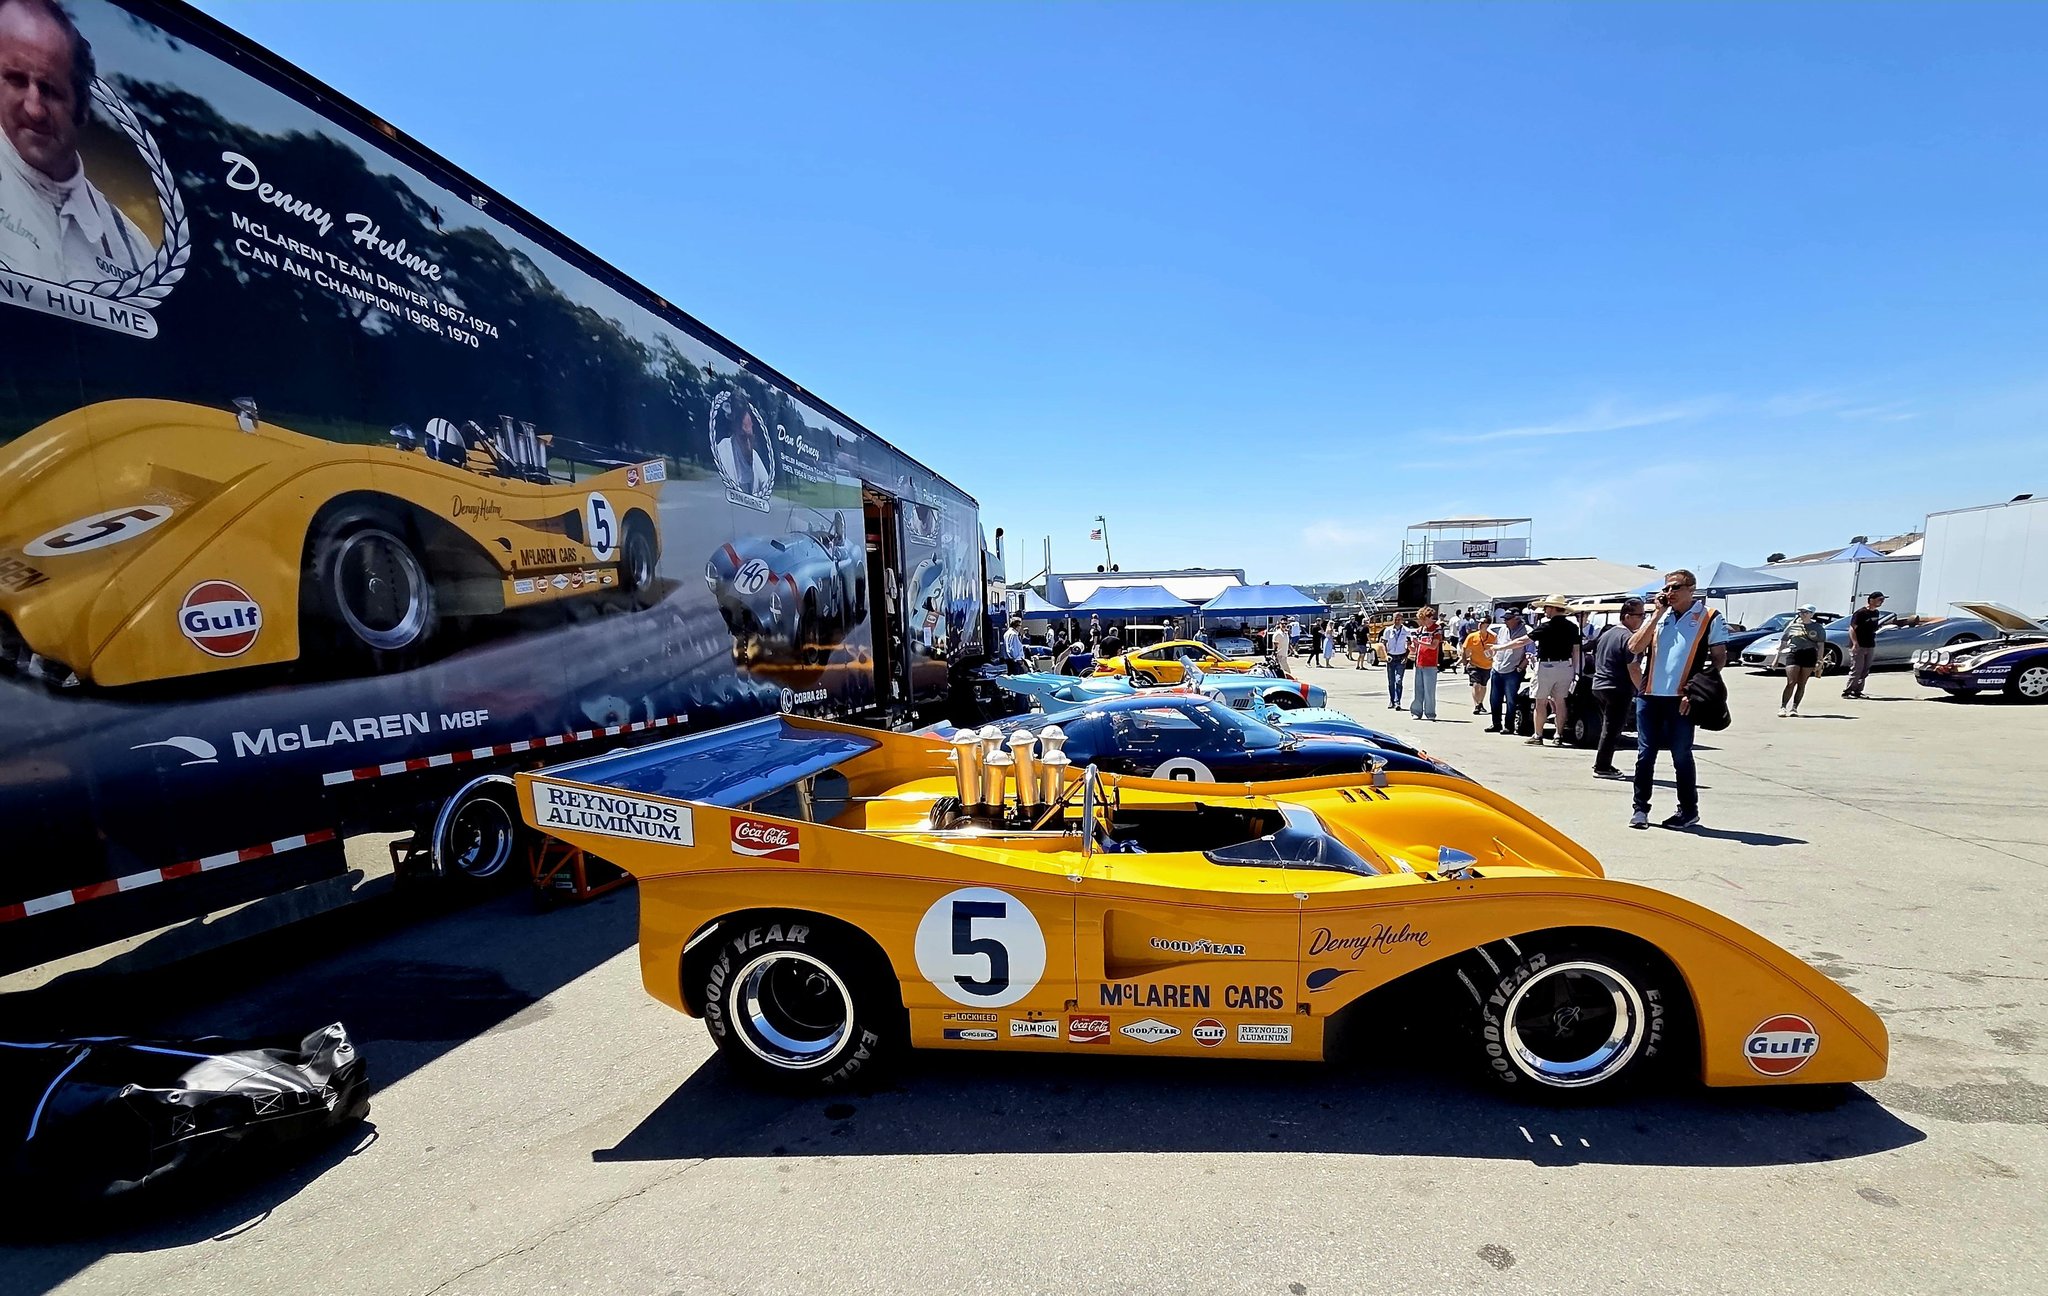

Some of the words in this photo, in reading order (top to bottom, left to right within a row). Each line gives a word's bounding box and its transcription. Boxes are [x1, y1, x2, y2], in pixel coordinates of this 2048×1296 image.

[222, 151, 334, 237] Denny
[345, 213, 442, 281] Hulme
[235, 238, 279, 269] CAN
[282, 257, 311, 281] AM
[314, 270, 400, 317] CHAMPION
[405, 307, 444, 336] 1968,
[447, 325, 480, 349] 1970
[325, 252, 374, 285] TEAM
[376, 273, 429, 309] DRIVER
[433, 300, 499, 339] 1967-1974
[47, 290, 148, 333] HULME
[777, 424, 794, 447] Dan
[796, 435, 820, 461] Gurney
[453, 495, 479, 522] Denny
[44, 509, 160, 549] 5
[592, 499, 610, 553] 5
[520, 549, 557, 567] McLAREN
[560, 547, 577, 562] CARS
[734, 562, 768, 593] 146
[184, 606, 258, 633] Gulf
[793, 690, 816, 705] COBRA
[232, 712, 431, 758] McLAREN
[440, 709, 490, 731] M8F
[547, 787, 677, 823] REYNOLDS
[547, 807, 682, 841] ALUMINUM
[735, 821, 791, 845] Coca-Cola
[952, 901, 1010, 997] 5
[1309, 927, 1371, 960] Denny
[1371, 923, 1431, 955] Hulme
[1100, 983, 1210, 1008] McLAREN
[1224, 984, 1283, 1010] CARS
[957, 1013, 997, 1021] LOCKHEED
[1011, 1023, 1057, 1033] CHAMPION
[1069, 1019, 1109, 1032] Coca-Cola
[1194, 1028, 1225, 1037] Gulf
[1241, 1026, 1288, 1034] REYNOLDS
[1646, 989, 1664, 1057] EAGLE
[1240, 1034, 1288, 1042] ALUMINUM
[1748, 1036, 1816, 1054] Gulf
